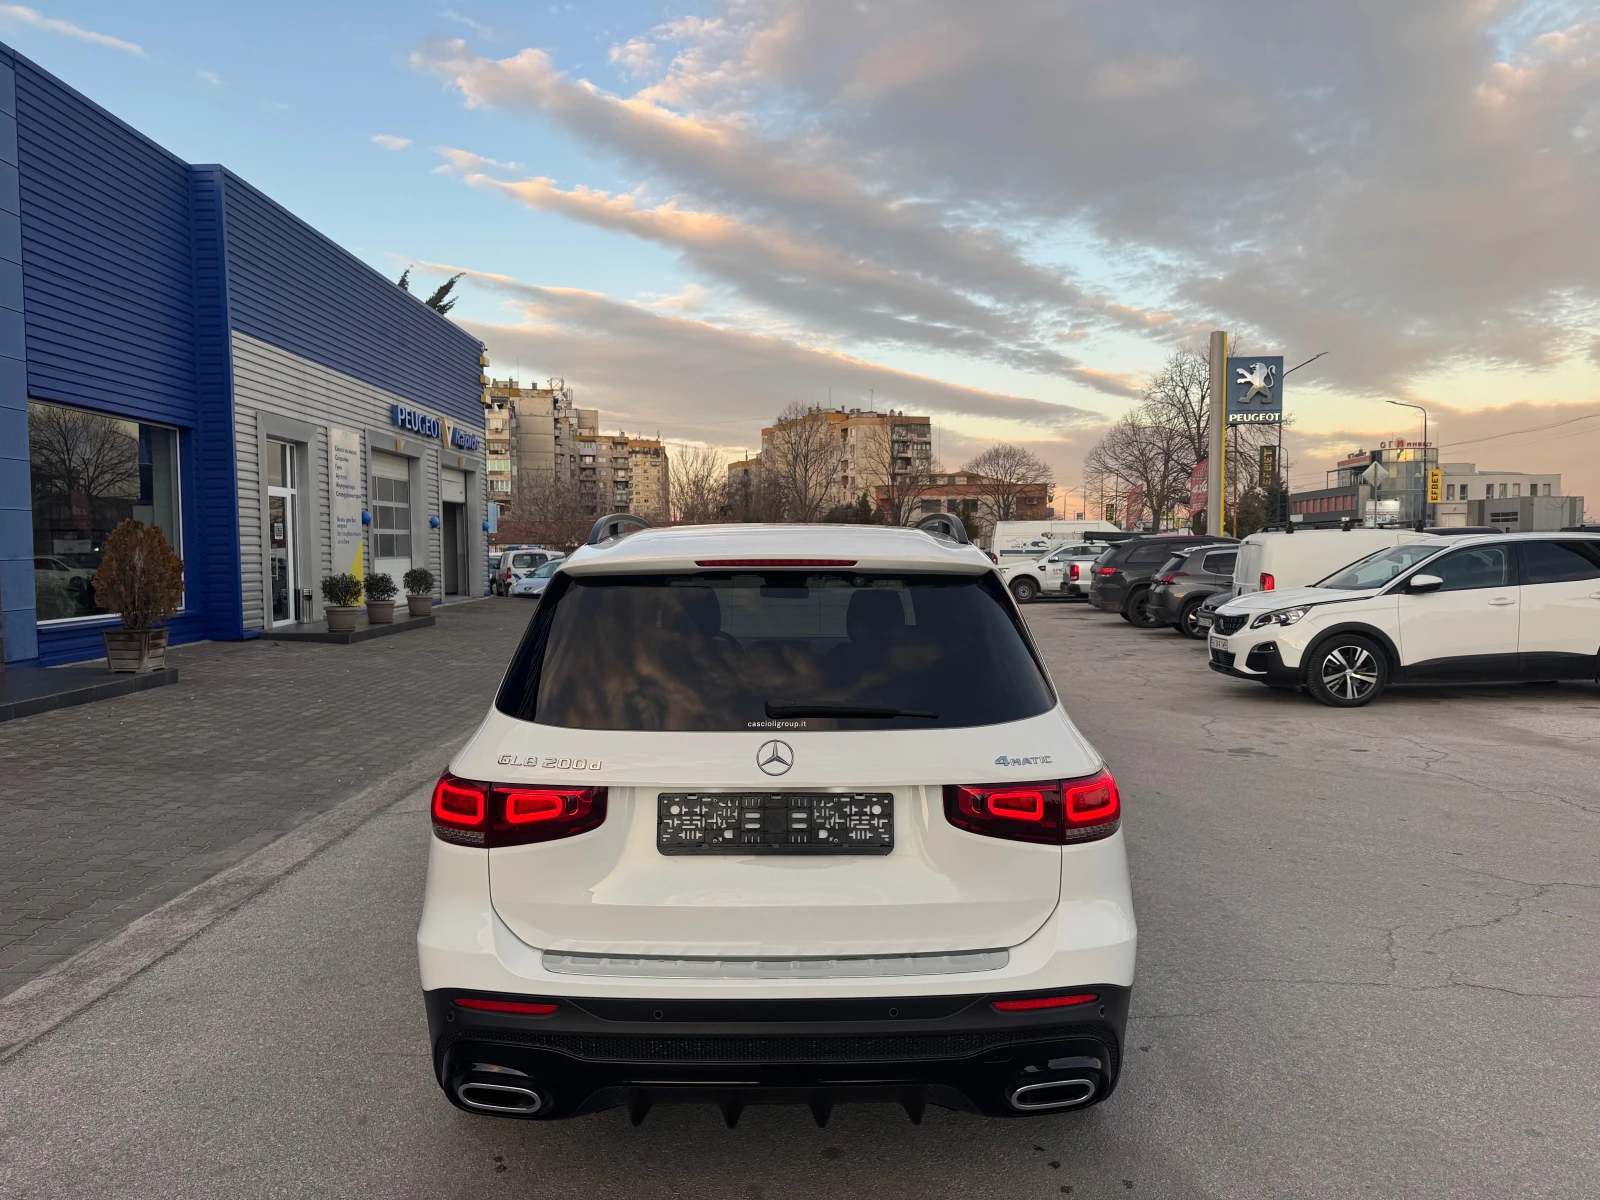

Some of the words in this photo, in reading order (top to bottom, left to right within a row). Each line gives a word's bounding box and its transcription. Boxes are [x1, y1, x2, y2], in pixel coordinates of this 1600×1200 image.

[398, 407, 442, 439] PEUGEOT
[1229, 412, 1281, 422] PEUGEOT
[1262, 448, 1273, 486] EFBET
[1431, 471, 1439, 501] EFBET
[747, 720, 807, 729] cascioligroup.it
[498, 754, 538, 767] GLB
[995, 755, 1053, 767] 4MATIC
